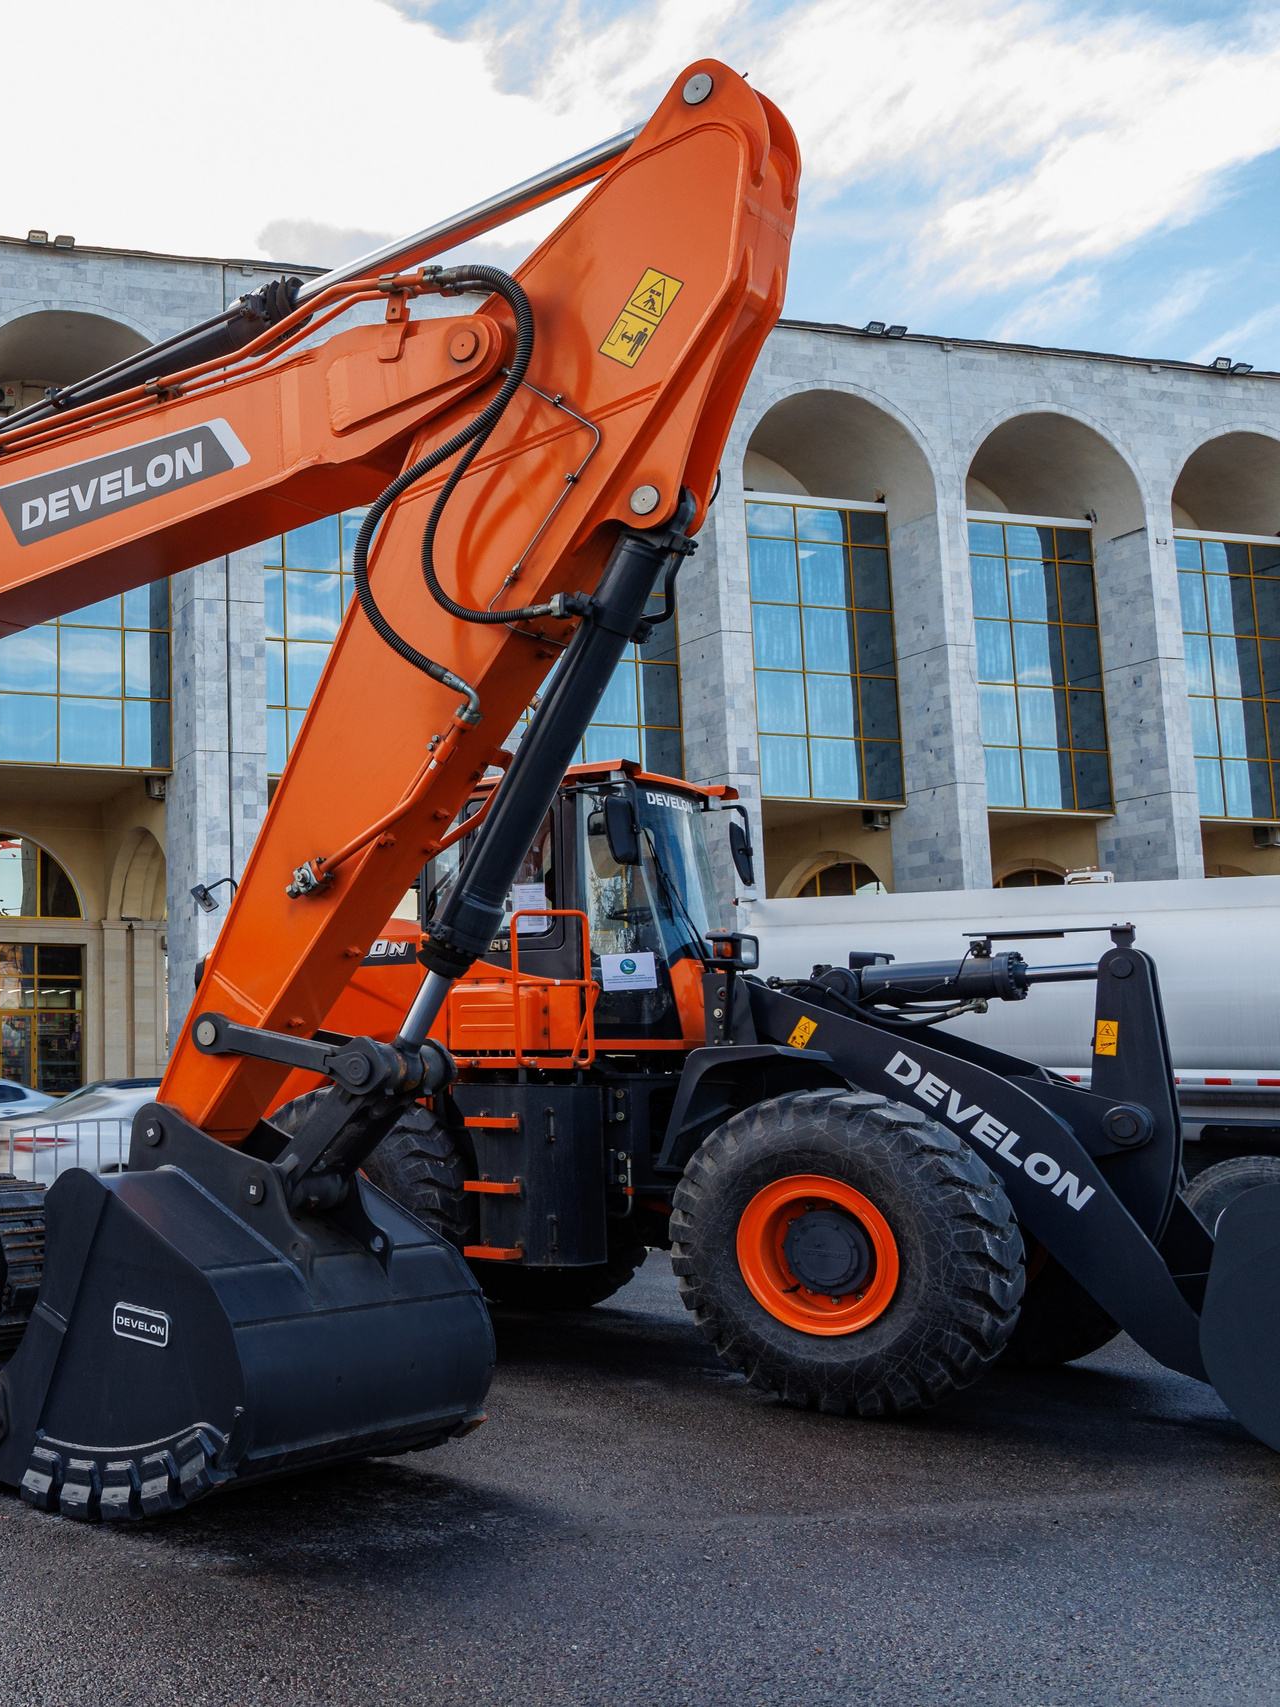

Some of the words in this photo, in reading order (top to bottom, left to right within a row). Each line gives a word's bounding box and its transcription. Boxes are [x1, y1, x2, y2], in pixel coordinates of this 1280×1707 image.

[21, 441, 202, 531] DEVELON
[645, 791, 694, 814] DEVELON
[884, 1050, 1096, 1212] DEVELON
[116, 1315, 165, 1336] DEVELON
